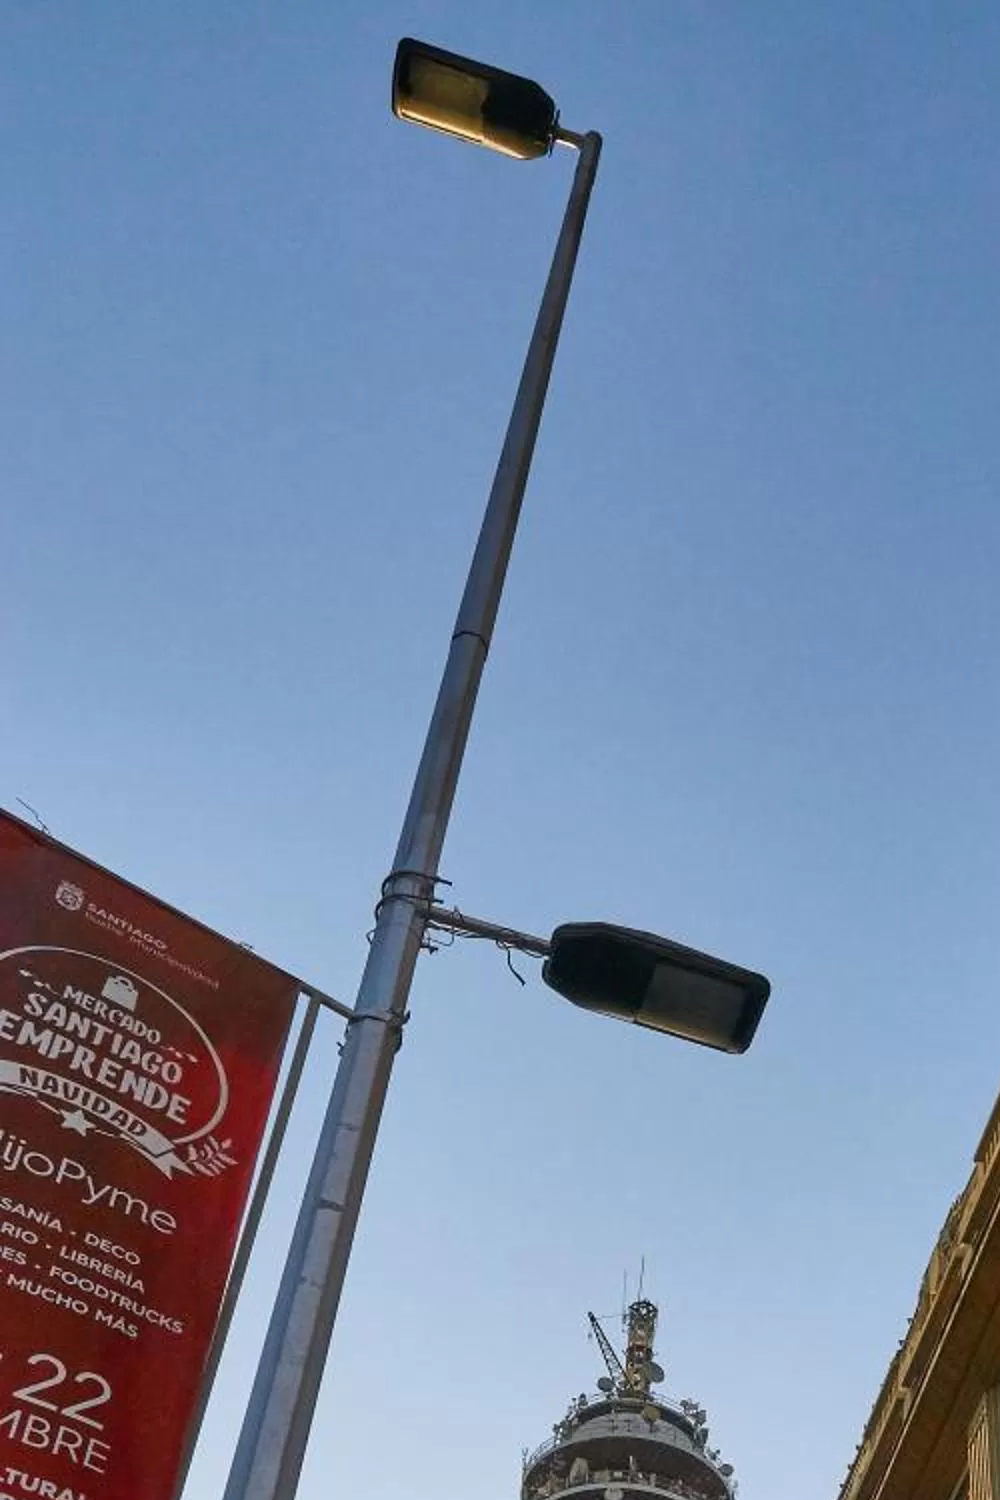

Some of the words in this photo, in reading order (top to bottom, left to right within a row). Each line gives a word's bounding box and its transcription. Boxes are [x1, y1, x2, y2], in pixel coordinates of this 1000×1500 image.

[24, 993, 182, 1083] SANTIAGO
[63, 985, 161, 1044] MERCADO
[0, 1009, 191, 1124] EMPRENDE
[19, 1067, 147, 1137] NAVIDAD
[0, 1129, 177, 1235] ijoPyme
[1, 1222, 39, 1244] RIO
[59, 1245, 145, 1293] LIBRERÍA
[84, 1233, 141, 1265] DECO
[0, 1246, 27, 1265] ES
[50, 1266, 184, 1334] FOODTRUCKS
[7, 1273, 89, 1314] MUCHO
[95, 1309, 139, 1338] MÁS
[12, 1354, 112, 1431] 22
